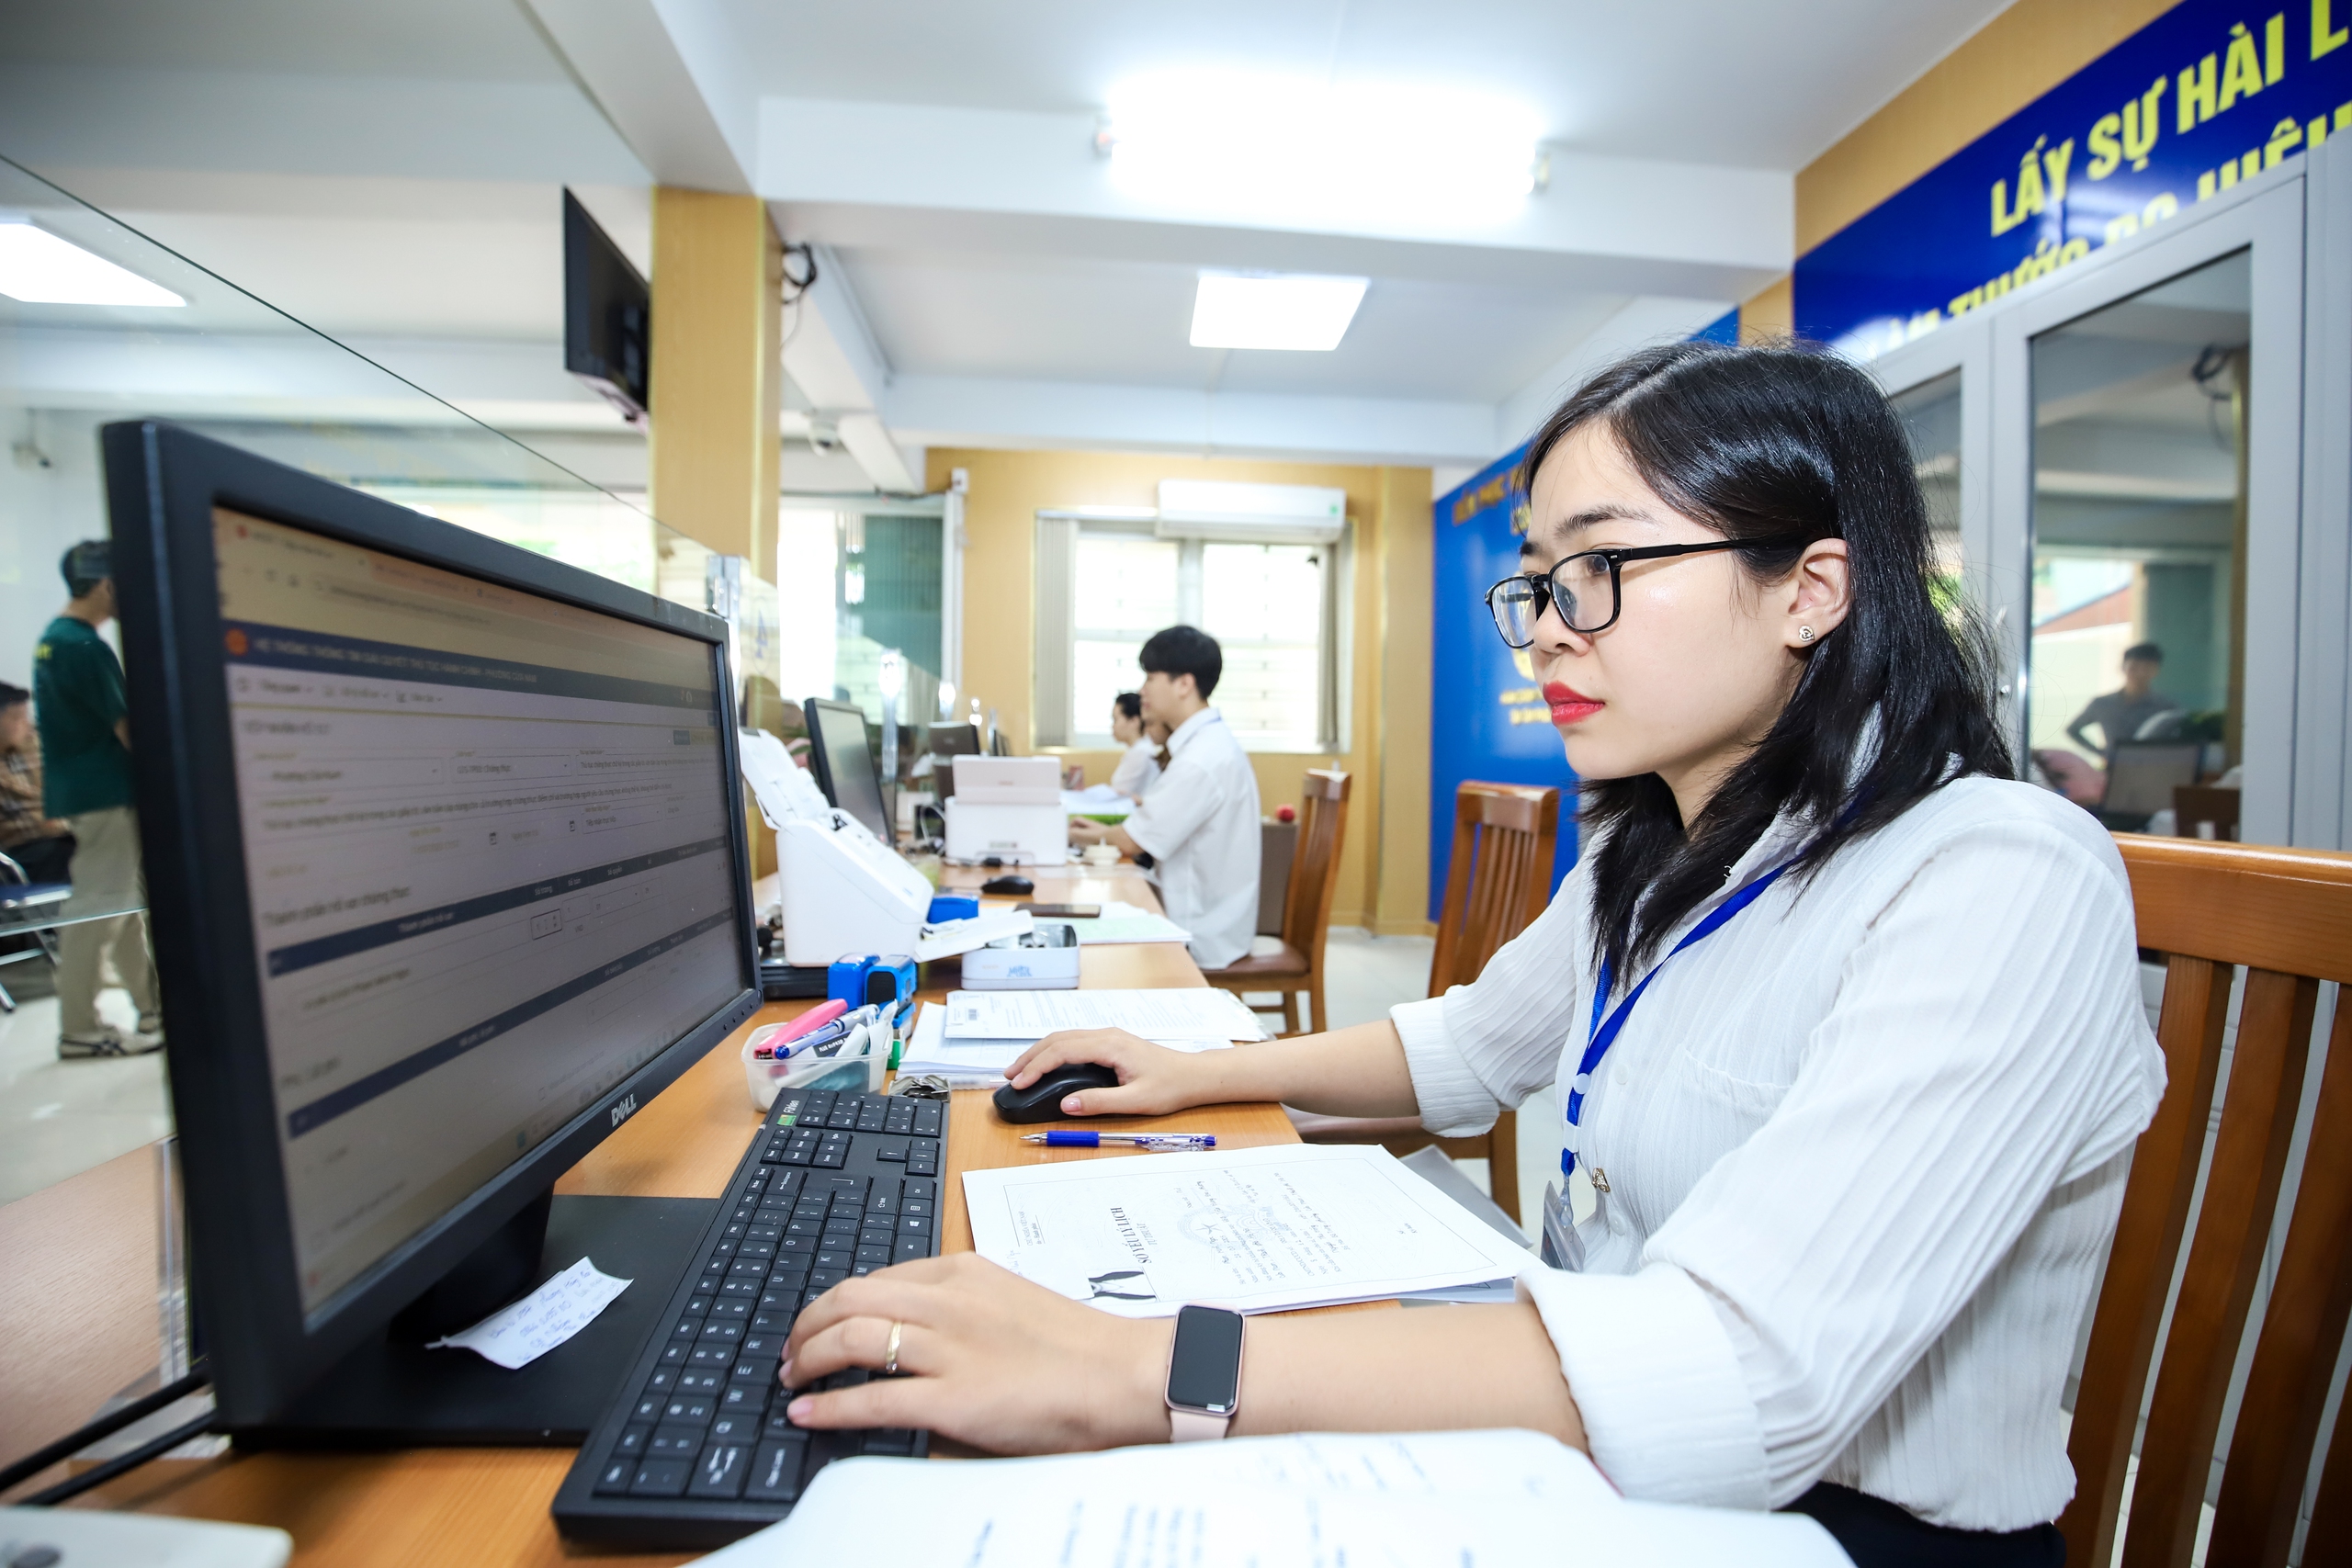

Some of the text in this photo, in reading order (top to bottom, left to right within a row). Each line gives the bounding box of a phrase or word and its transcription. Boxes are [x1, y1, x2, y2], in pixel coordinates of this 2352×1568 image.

[1991, 134, 2074, 238] LẤY
[2086, 74, 2168, 182] SỰ
[2177, 12, 2286, 135] HÀI
[611, 1093, 637, 1127] DELL
[1110, 1206, 1153, 1265] SƠ YẾU LÝ LỊCH
[747, 1340, 761, 1349] R
[737, 1366, 752, 1375] E
